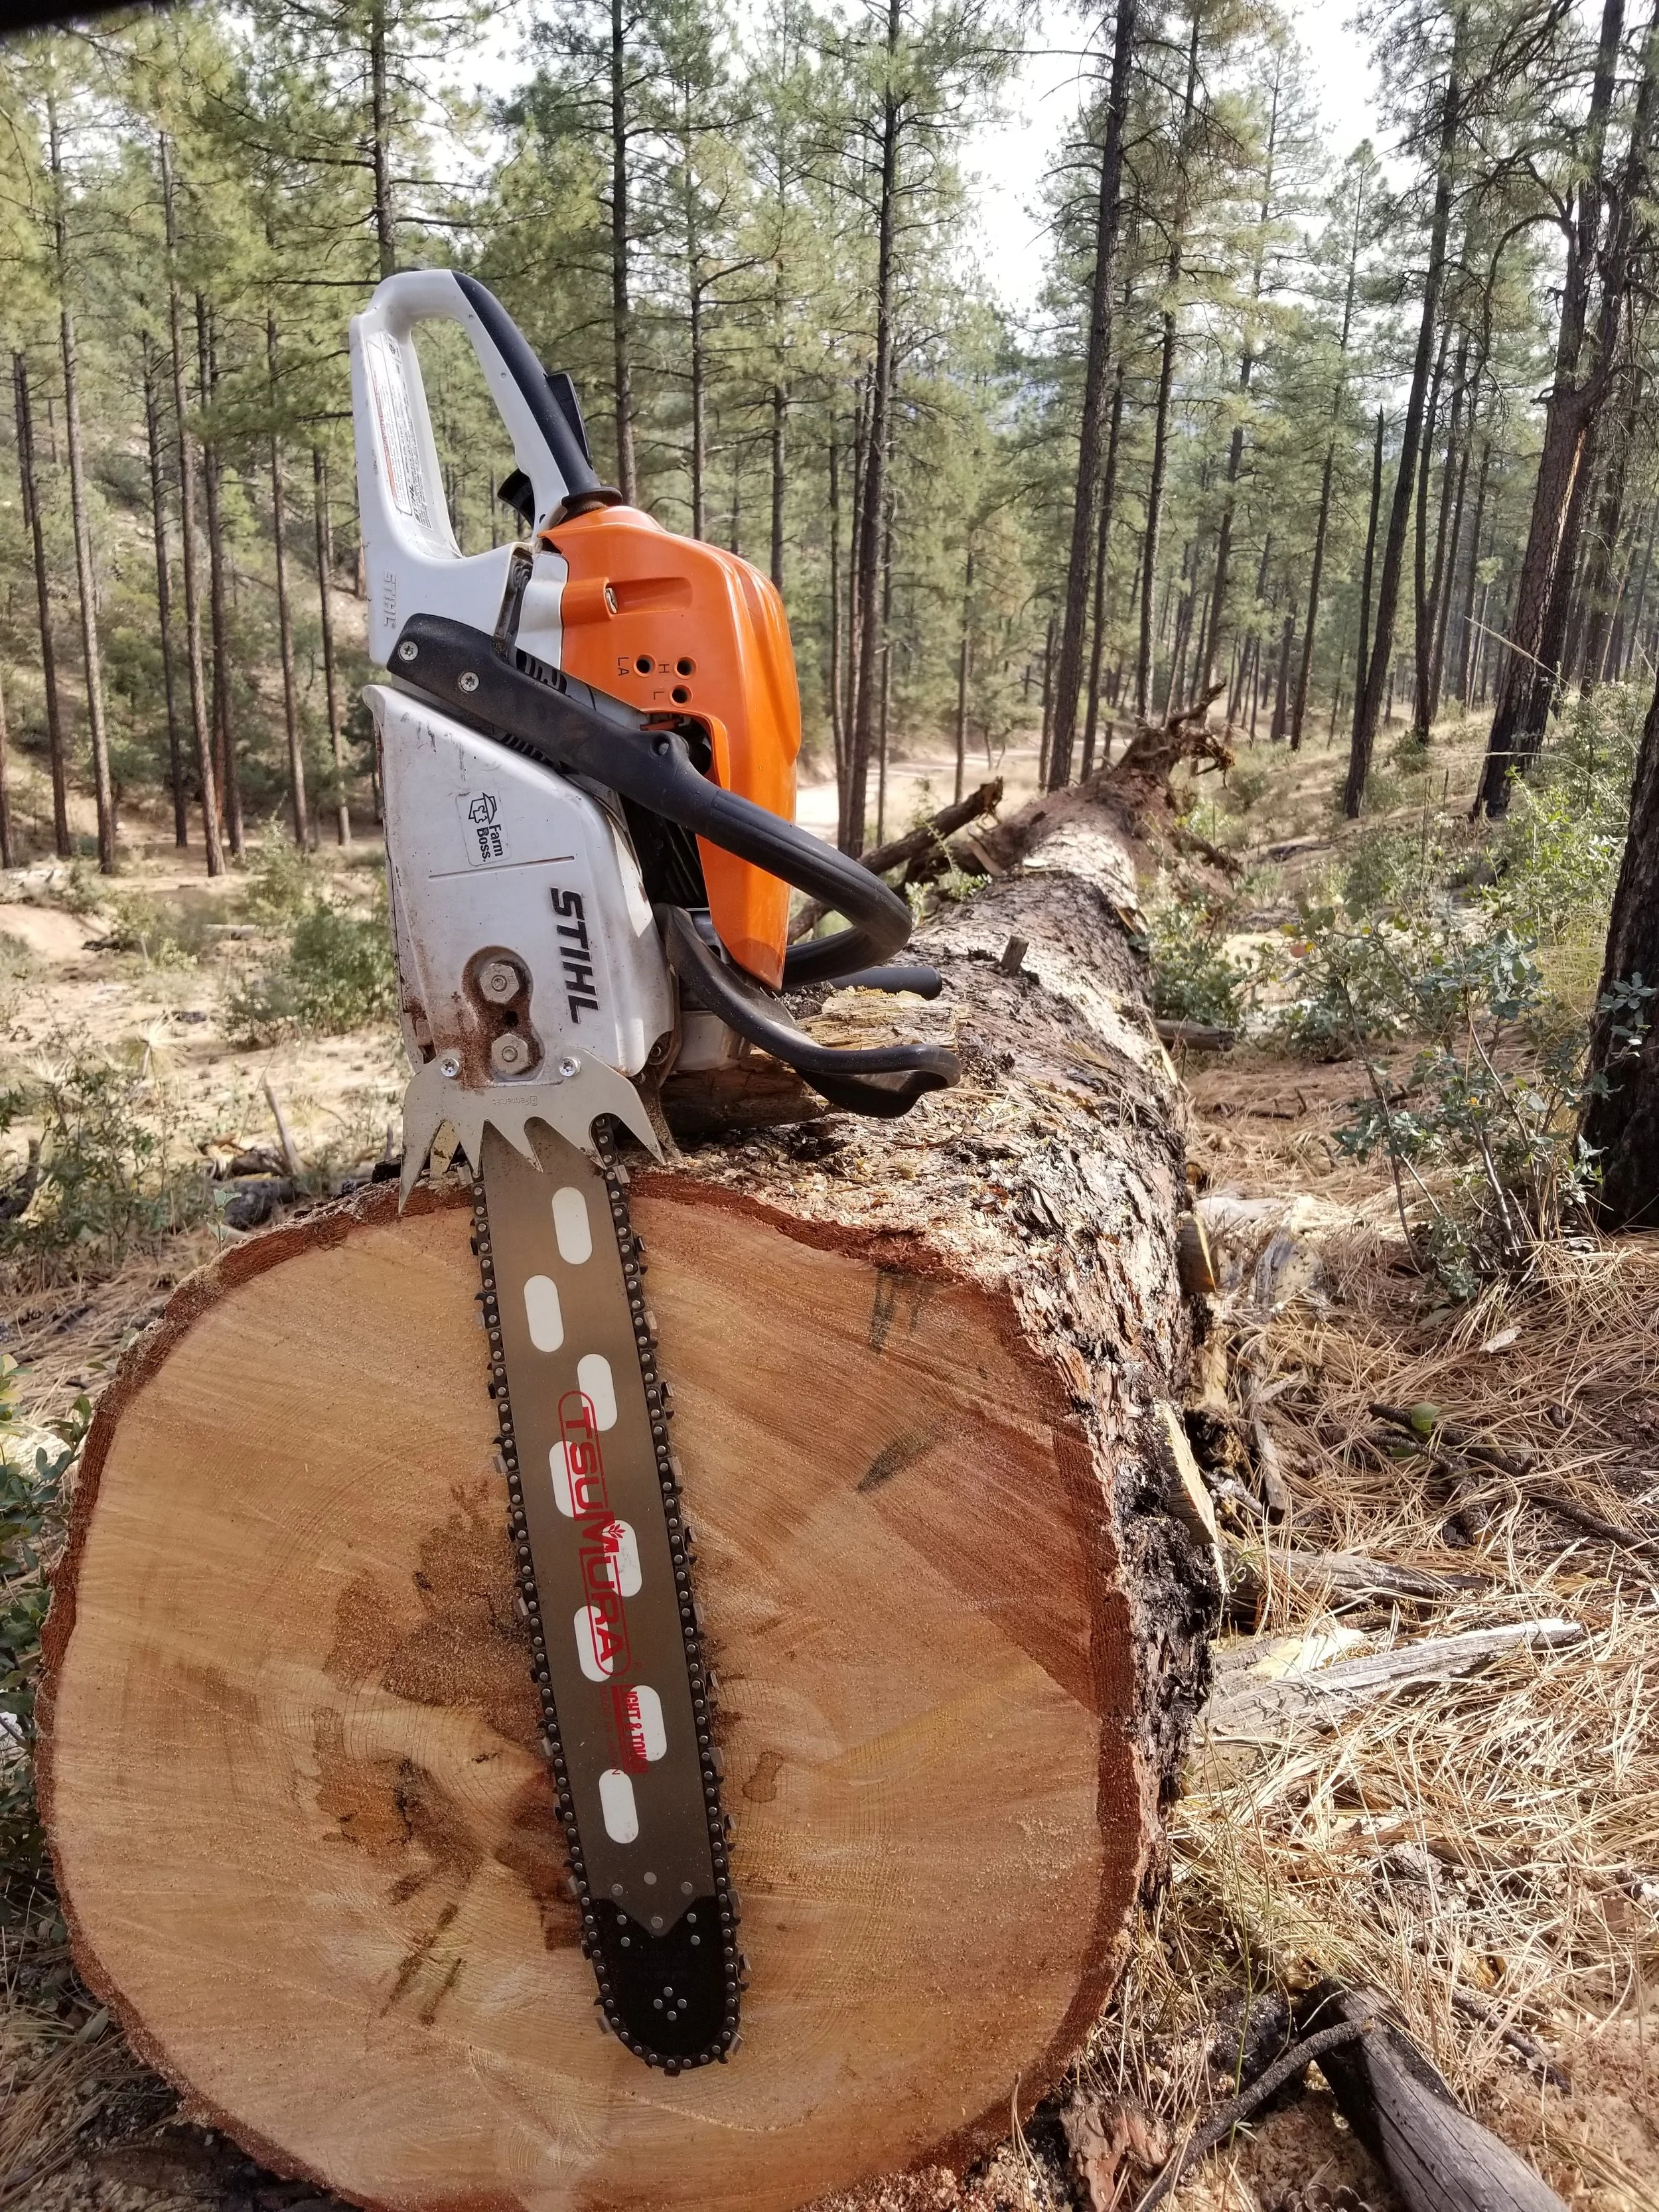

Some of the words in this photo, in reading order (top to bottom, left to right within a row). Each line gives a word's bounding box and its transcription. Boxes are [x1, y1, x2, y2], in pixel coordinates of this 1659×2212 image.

[618, 657, 630, 676] LA
[658, 664, 670, 674] H
[653, 691, 665, 701] L
[489, 824, 504, 857] Farm
[550, 887, 600, 1024] STIHL
[565, 1406, 624, 1662] TSUMURA
